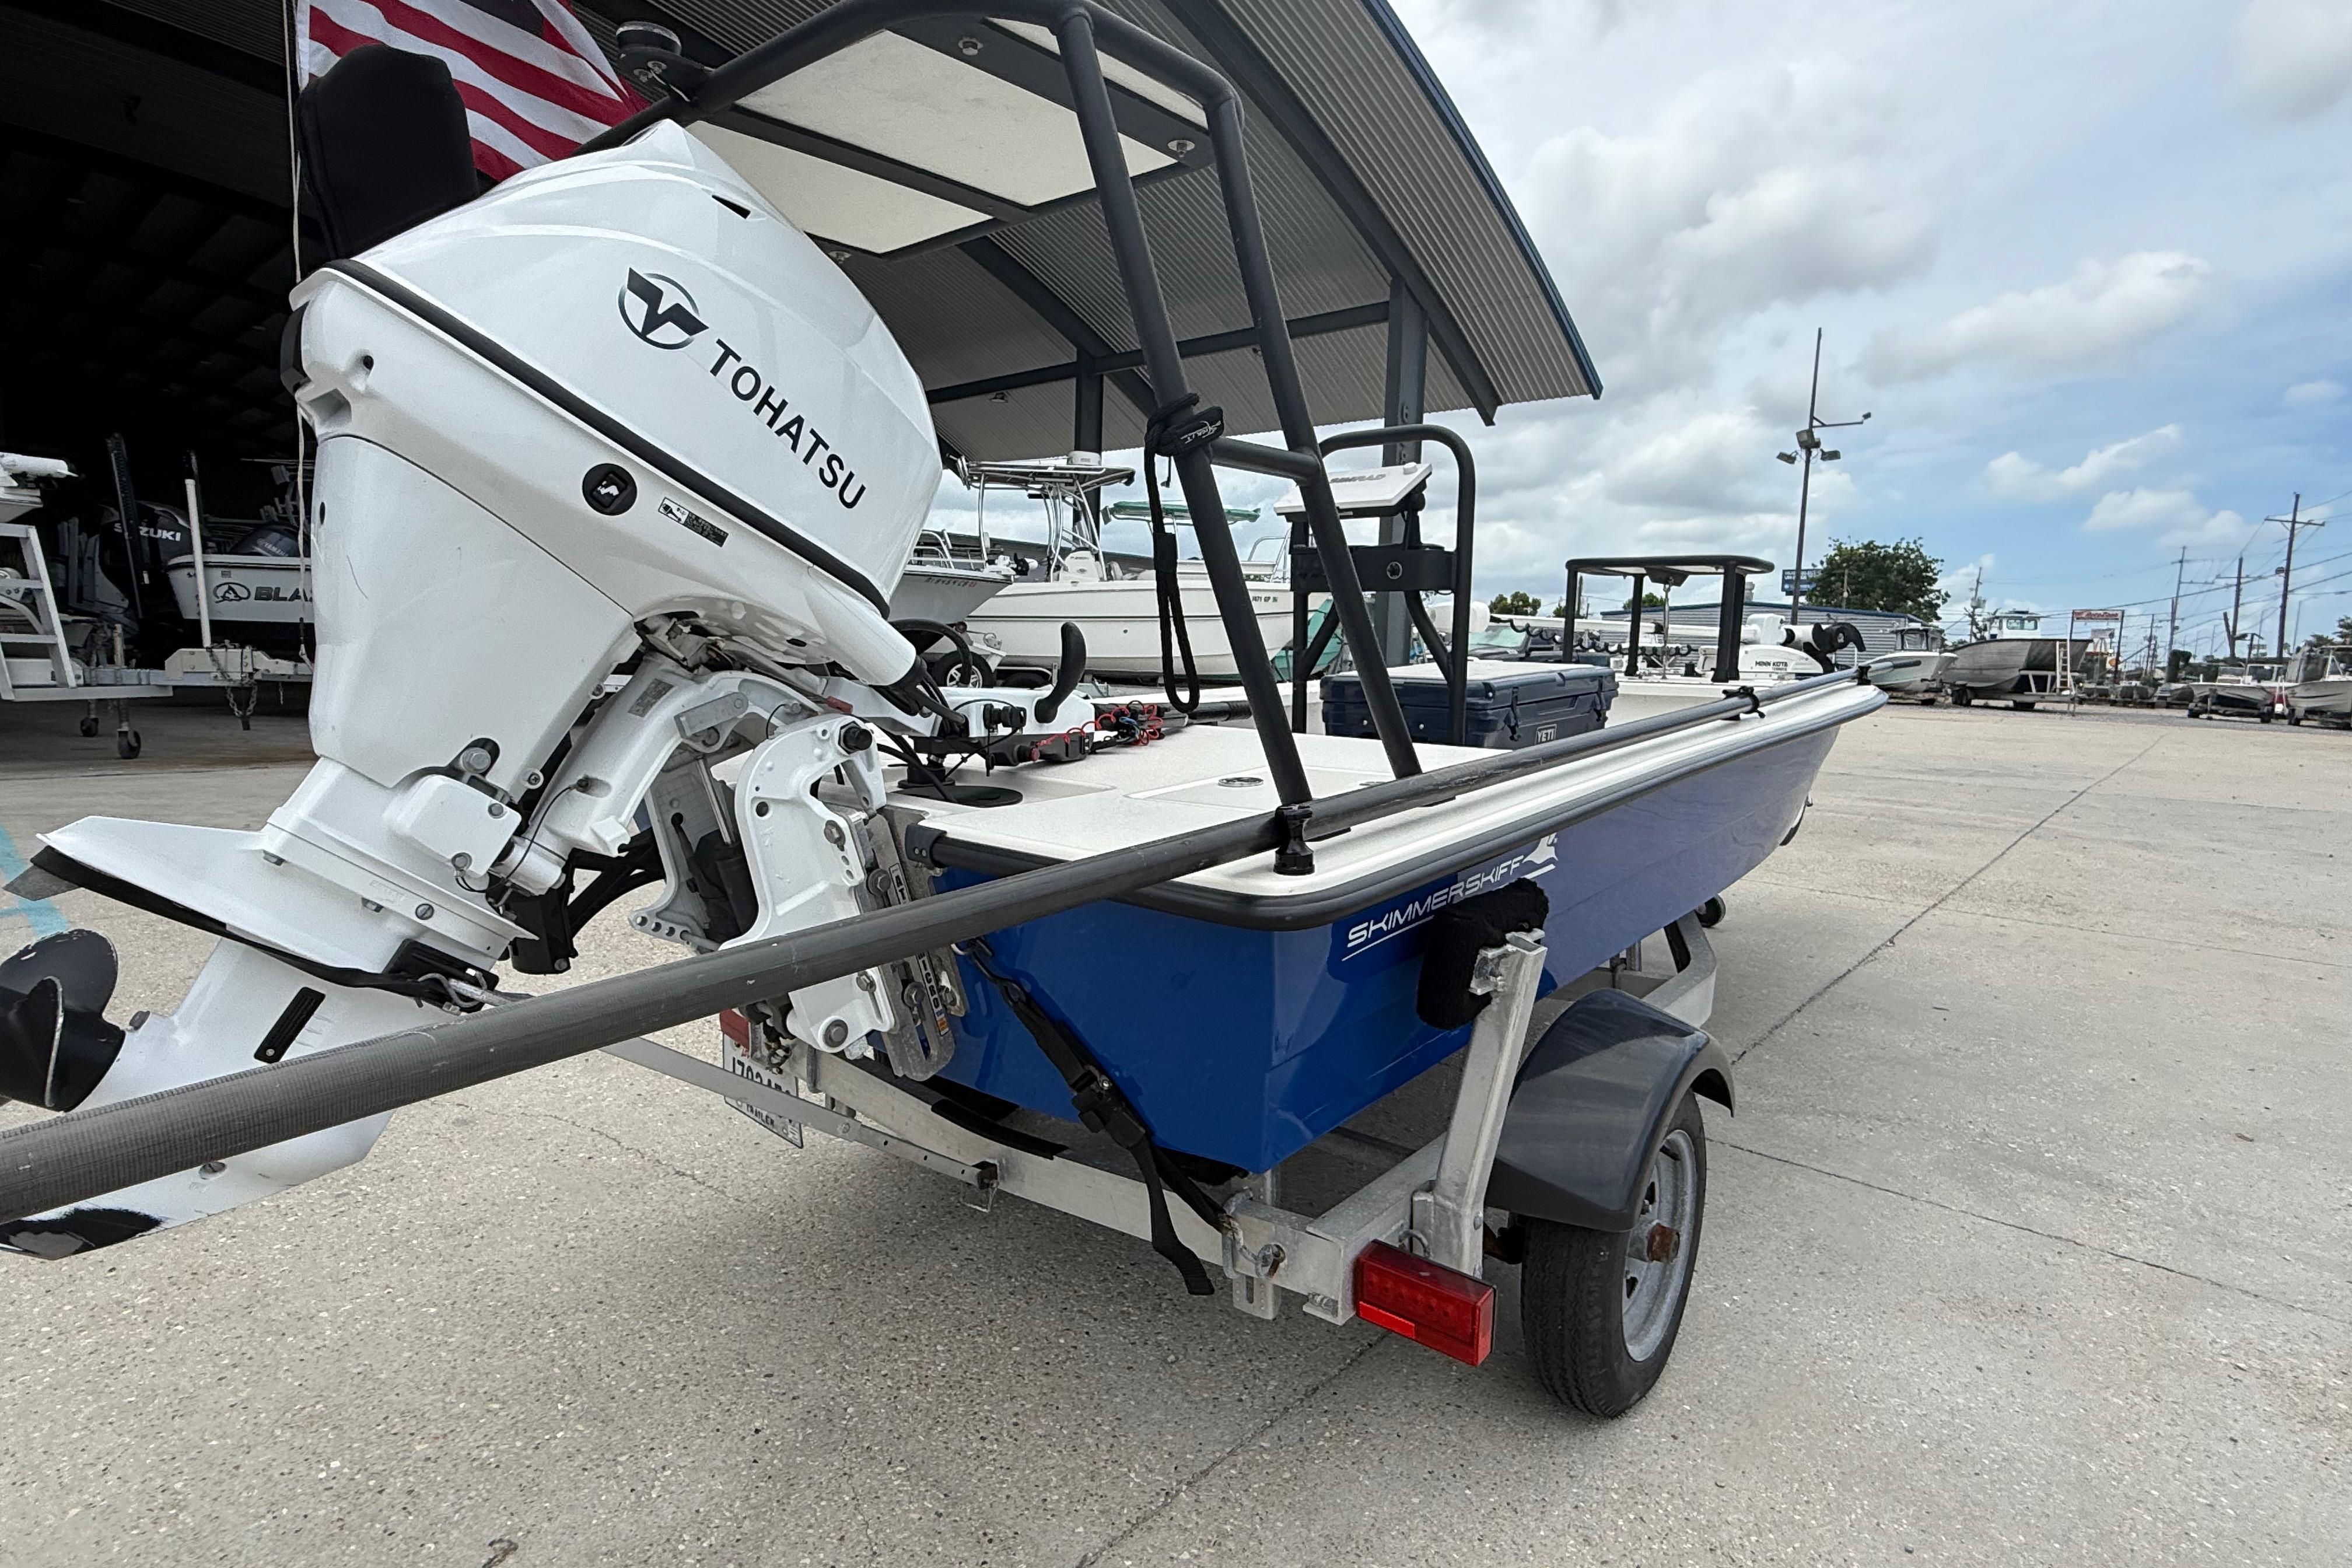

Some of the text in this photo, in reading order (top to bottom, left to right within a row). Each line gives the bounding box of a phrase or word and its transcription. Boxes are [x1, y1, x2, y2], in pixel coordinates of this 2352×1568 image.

[709, 338, 866, 509] TOHATSU
[113, 523, 181, 542] SZUKI
[254, 586, 313, 602] BLA
[1538, 728, 1555, 743] YETI
[1346, 855, 1524, 948] SKIMMERSKIFF
[746, 1104, 775, 1128] TRAILER
